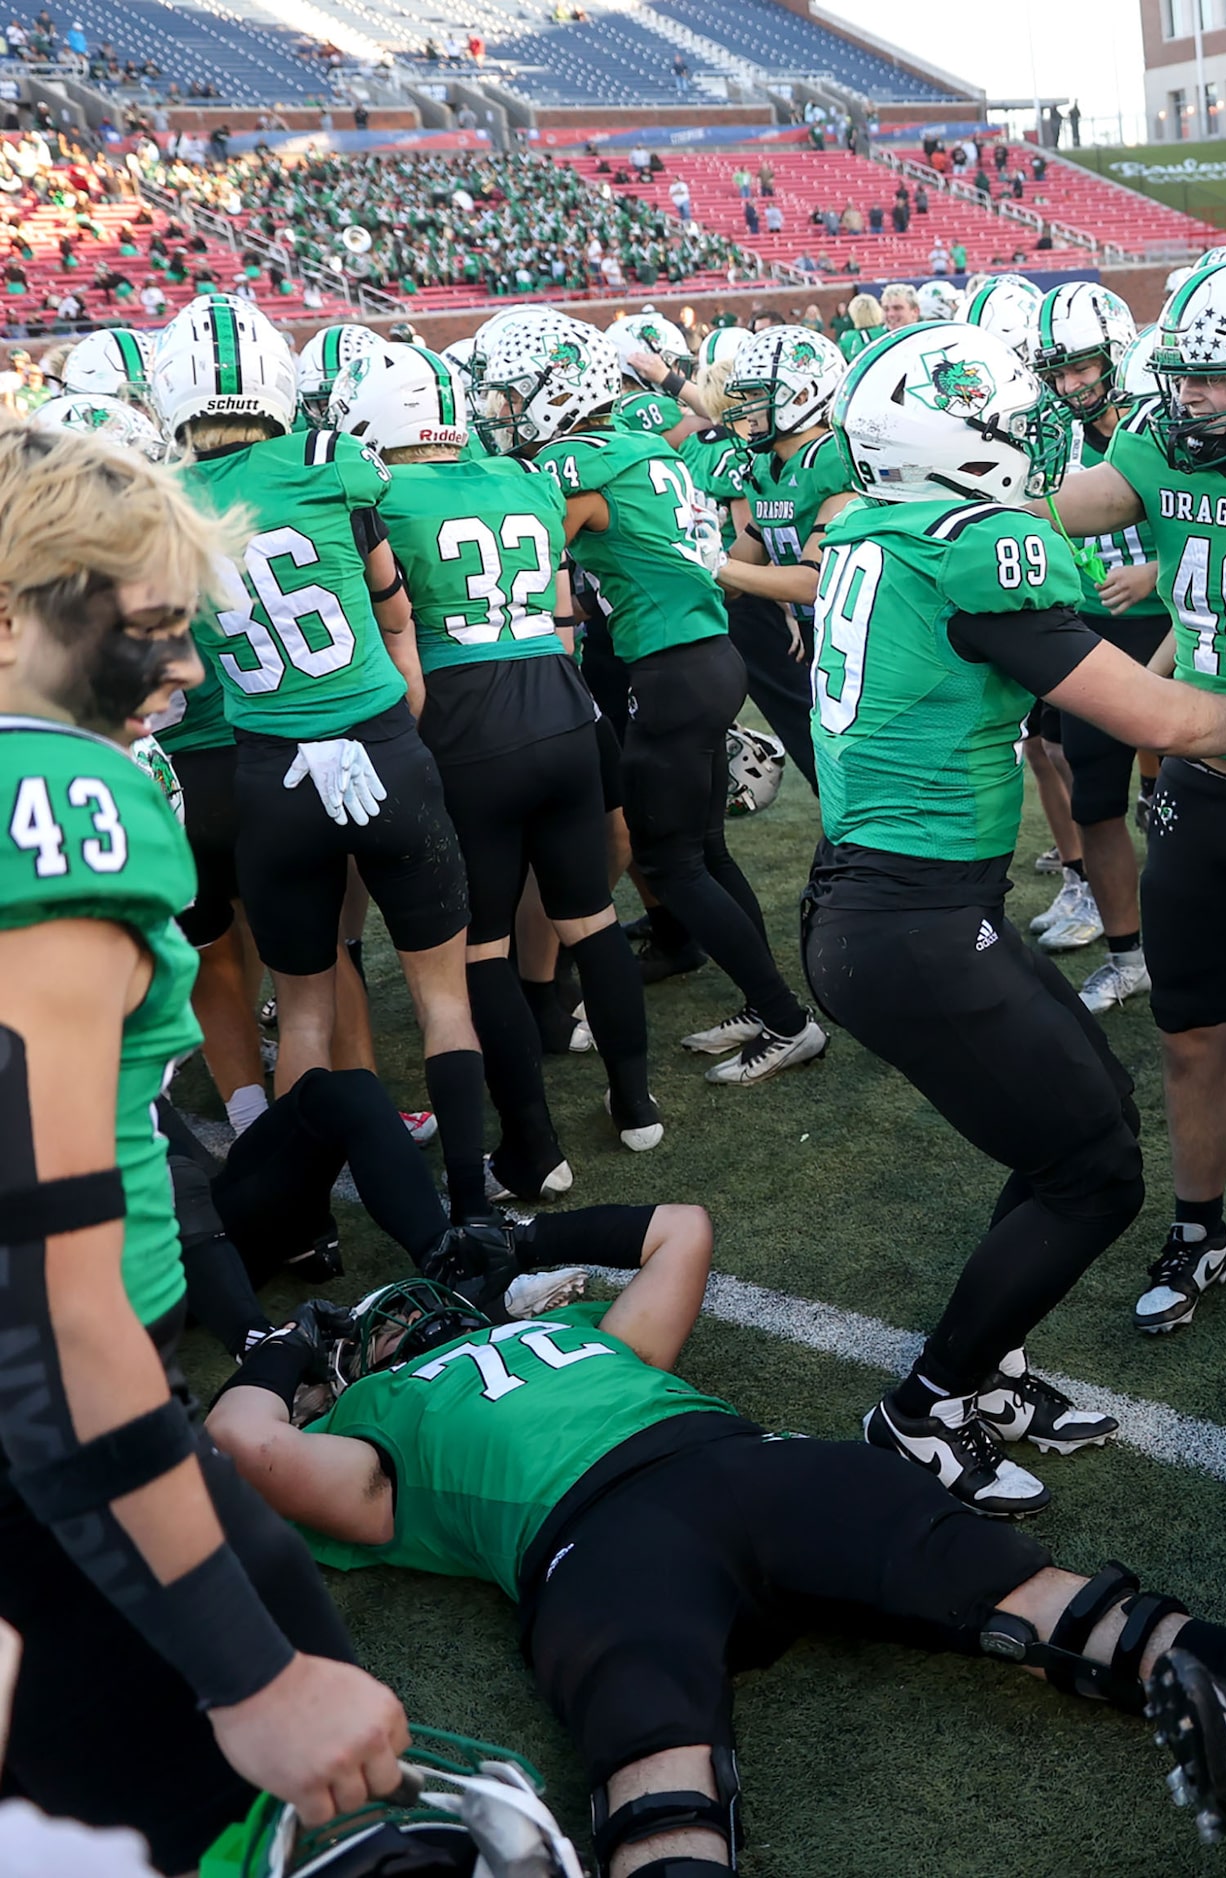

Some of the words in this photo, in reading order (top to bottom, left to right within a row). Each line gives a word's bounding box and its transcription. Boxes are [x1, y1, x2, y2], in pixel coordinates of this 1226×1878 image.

[207, 396, 259, 410] schutt
[635, 403, 664, 431] 38
[755, 500, 794, 520] DRAGONS
[436, 513, 555, 644] 32
[995, 534, 1047, 588] 89
[218, 525, 356, 694] 36
[10, 777, 128, 877] 43
[410, 1319, 620, 1402] 72
